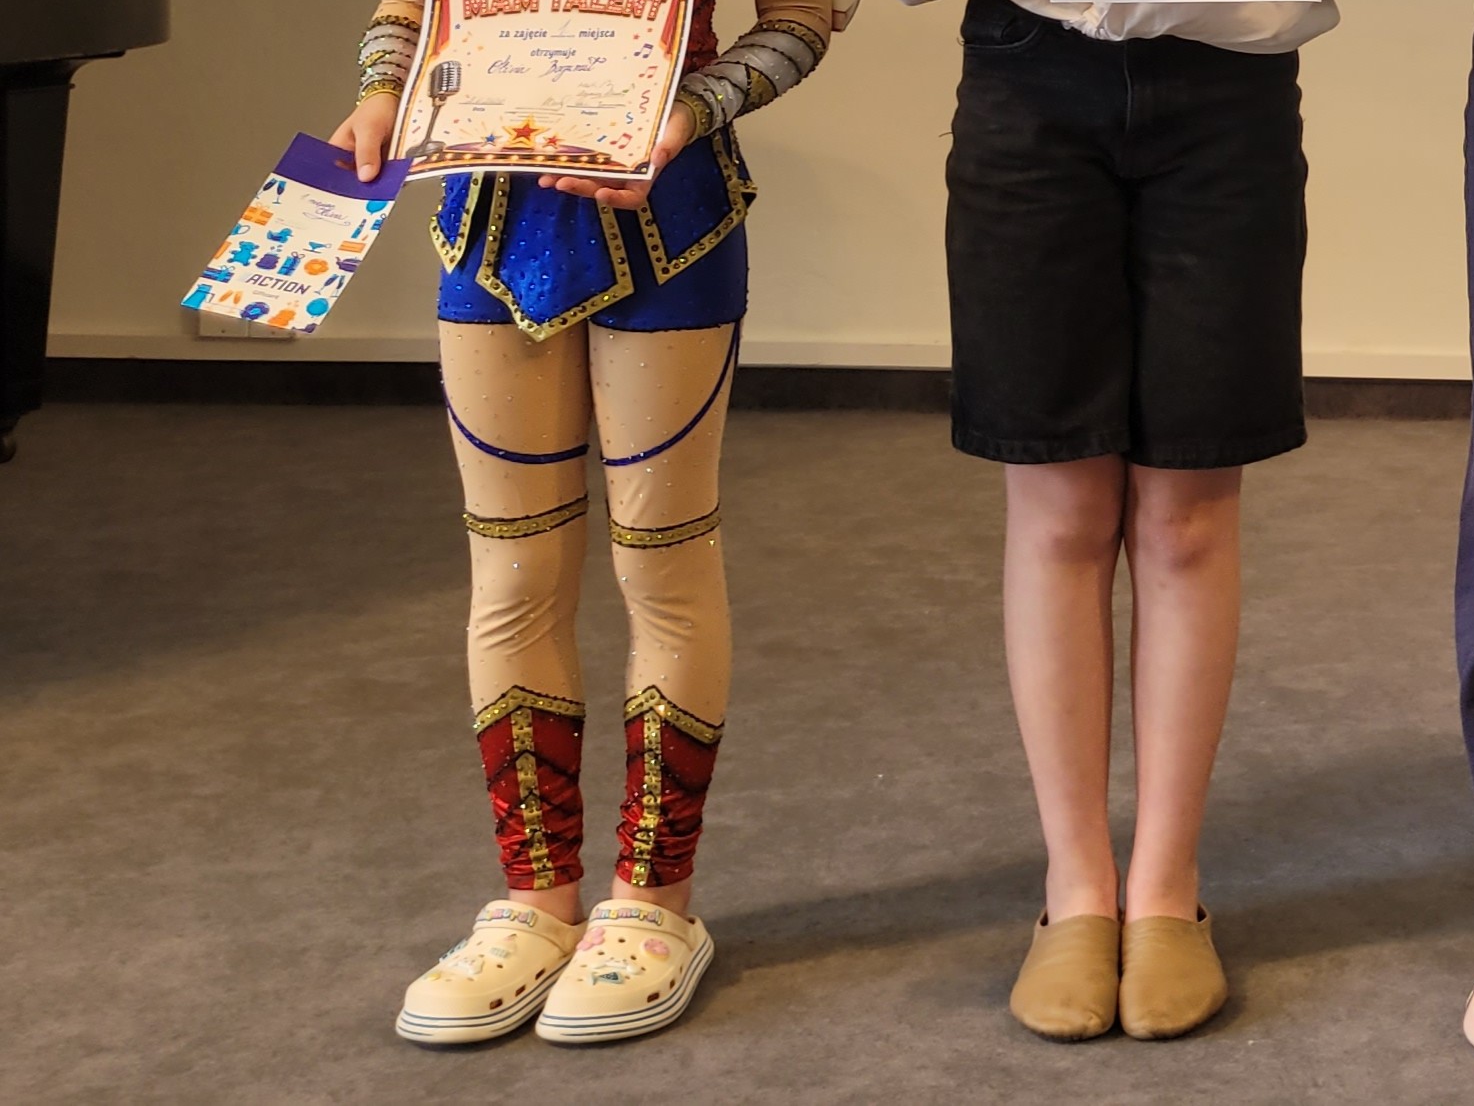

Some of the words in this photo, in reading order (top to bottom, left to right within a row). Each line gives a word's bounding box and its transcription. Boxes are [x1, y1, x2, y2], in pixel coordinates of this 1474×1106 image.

[499, 28, 510, 38] za
[513, 28, 548, 41] zajęcie
[579, 28, 616, 41] miejsca
[530, 47, 576, 59] otrzymuje
[246, 273, 311, 295] ACTION
